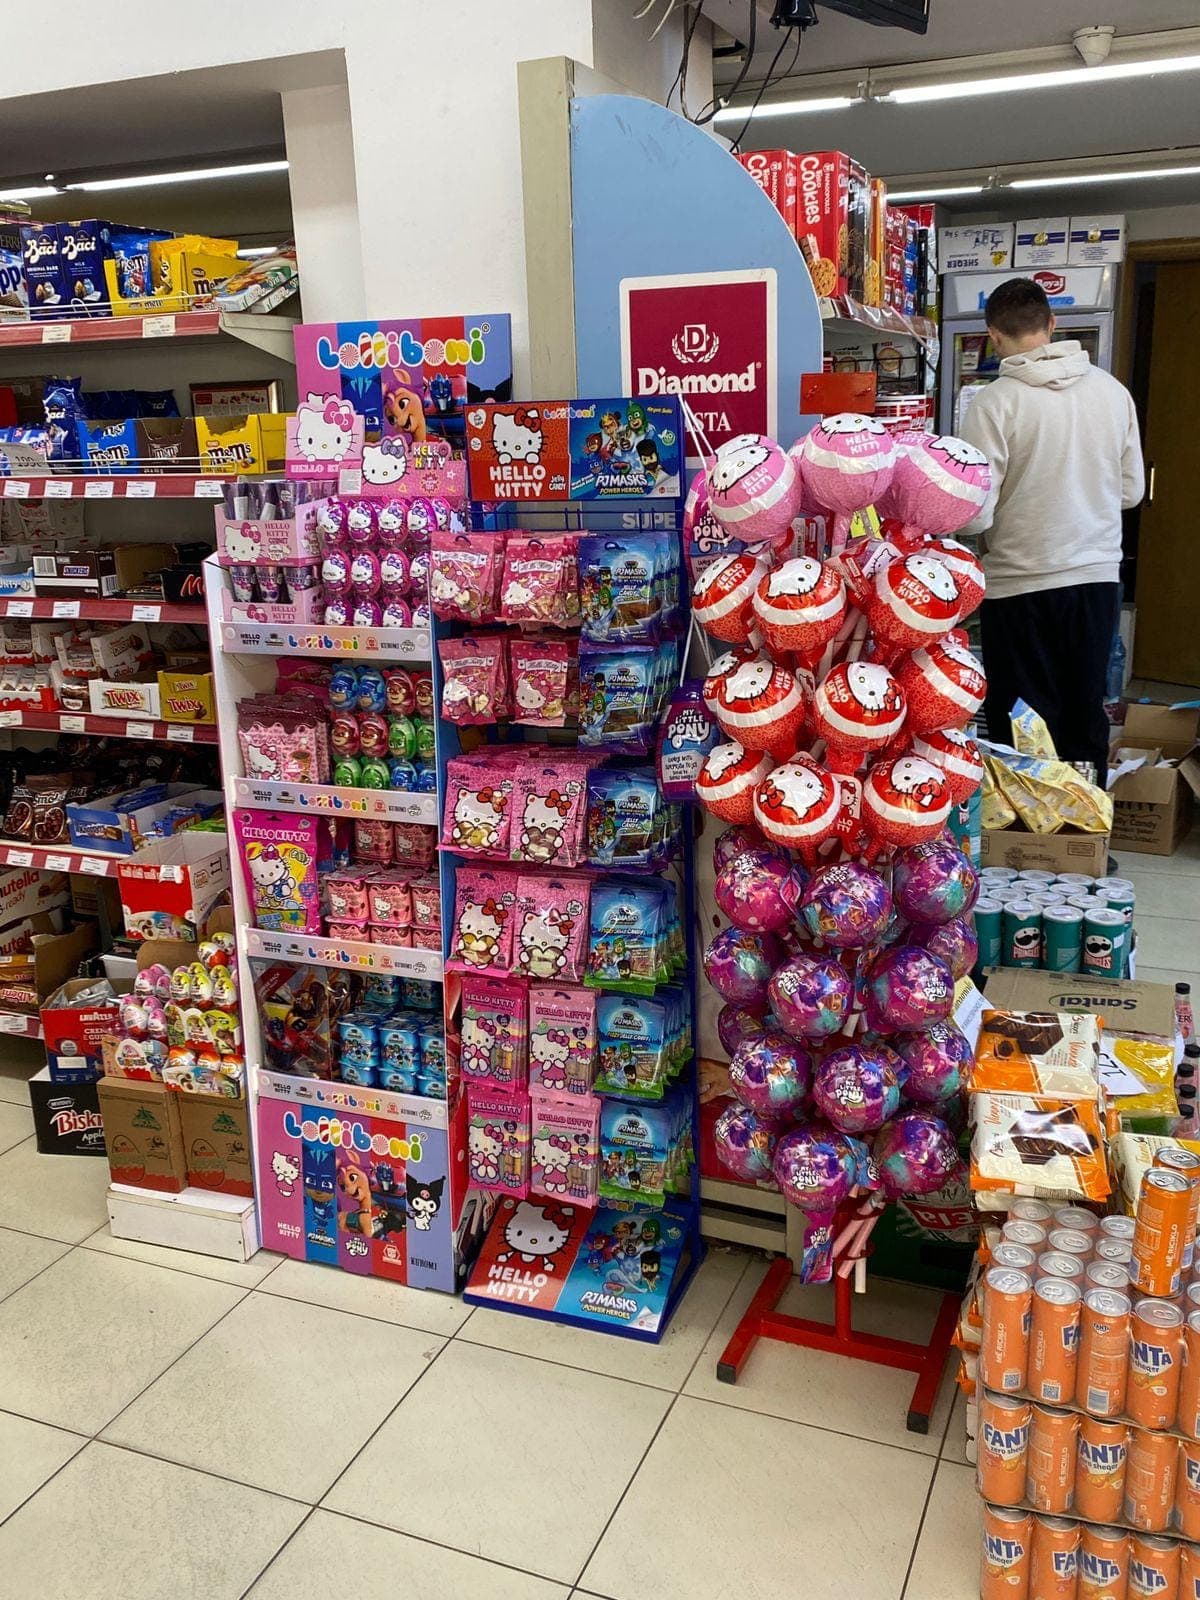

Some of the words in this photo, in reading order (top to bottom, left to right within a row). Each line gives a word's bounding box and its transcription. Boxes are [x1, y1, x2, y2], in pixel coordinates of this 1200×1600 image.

[800, 156, 821, 225] Cookies
[24, 239, 58, 264] Baci
[61, 235, 97, 260] Baci
[947, 258, 979, 269] SHEQER
[637, 361, 757, 396] Diamond
[290, 464, 324, 474] HELLO
[489, 465, 546, 481] HELLO
[494, 482, 543, 498] KITTY
[683, 708, 694, 716] MY
[667, 721, 711, 749] PONY
[242, 826, 275, 840] HELLO
[276, 830, 310, 842] KITTY
[465, 993, 490, 1003] HELLO
[492, 996, 516, 1009] KITTY
[1059, 994, 1138, 1011] Santal
[471, 1101, 497, 1111] HELLO
[498, 1105, 523, 1115] KITTY
[537, 1113, 566, 1124] HELLO
[566, 1117, 593, 1128] KITTY
[277, 1221, 301, 1233] HELLO
[279, 1228, 301, 1240] KITTY
[410, 1257, 437, 1271] KUROMI
[488, 1264, 549, 1287] HELLO
[486, 1280, 540, 1302] KITTY
